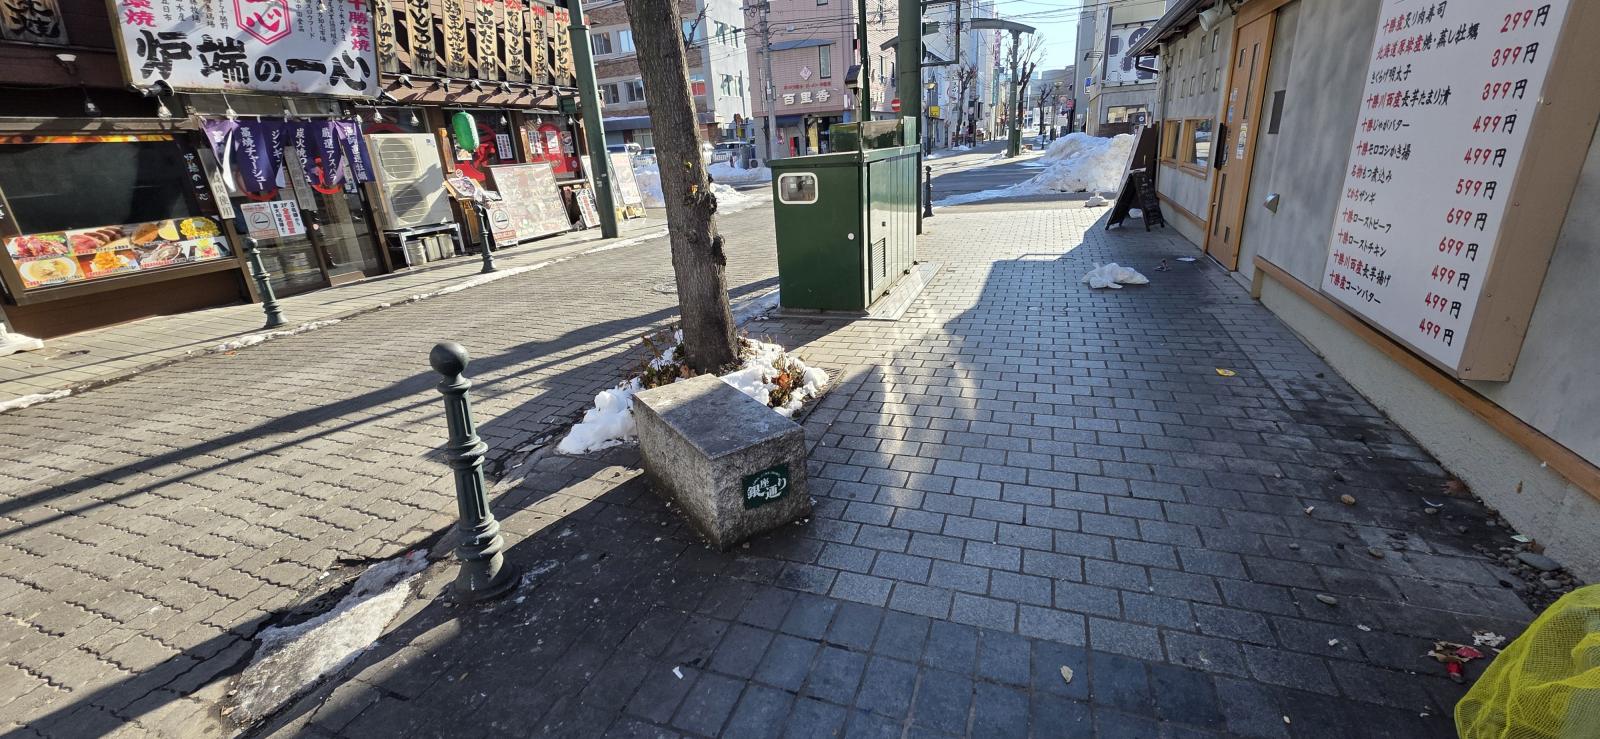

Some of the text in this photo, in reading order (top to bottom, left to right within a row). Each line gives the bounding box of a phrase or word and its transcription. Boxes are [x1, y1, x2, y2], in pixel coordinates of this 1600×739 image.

[136, 29, 370, 91] 炉端の一心
[782, 89, 830, 105] 百里香
[1342, 207, 1392, 233] 十勝ローストビーフ
[1338, 229, 1387, 257] 十勝ローストチキン
